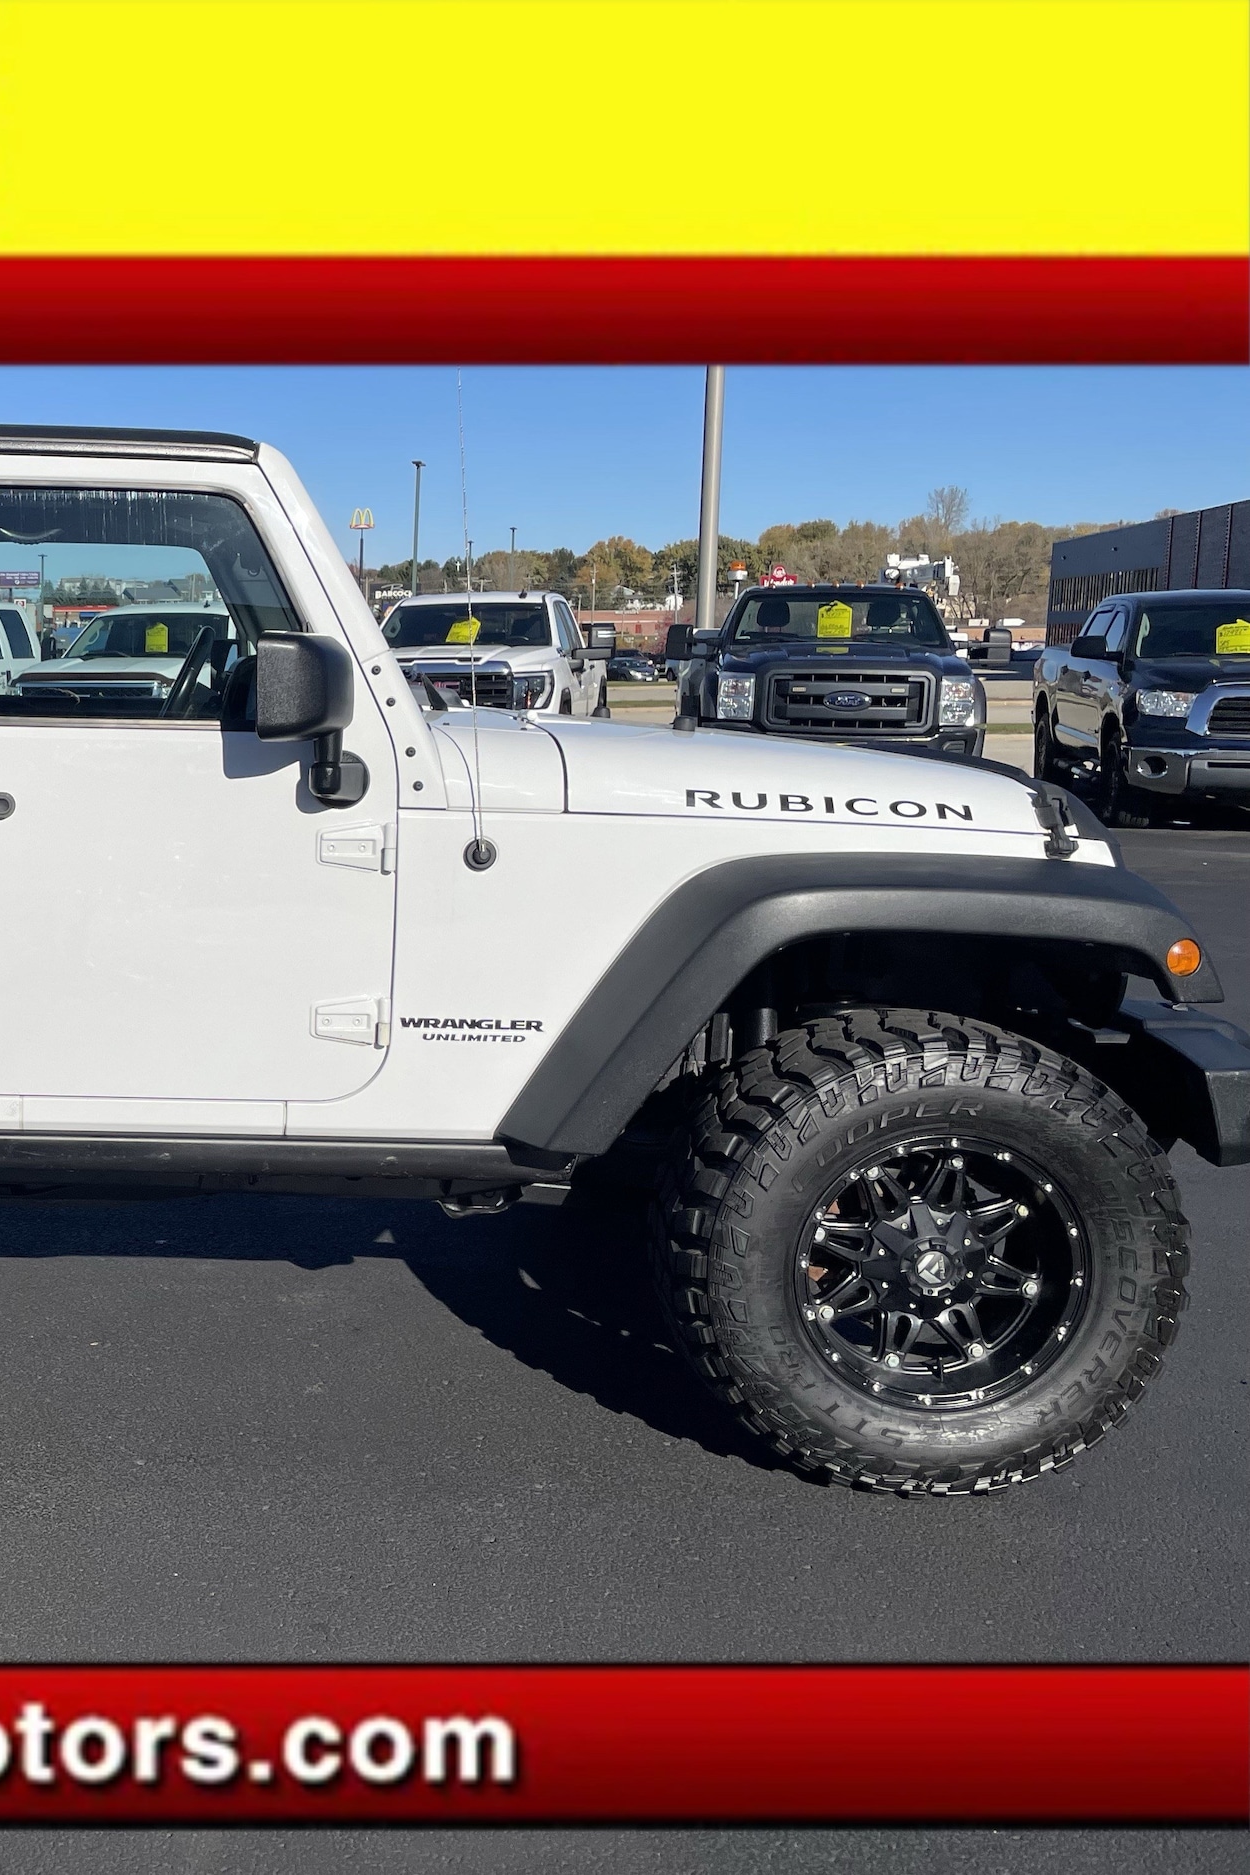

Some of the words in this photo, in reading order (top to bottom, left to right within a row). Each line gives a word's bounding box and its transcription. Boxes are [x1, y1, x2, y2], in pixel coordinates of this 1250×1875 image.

[685, 788, 974, 821] RUBICON
[399, 1017, 544, 1032] WRANGLER
[422, 1033, 526, 1043] UNLIMITED
[791, 1097, 984, 1193] COOPER
